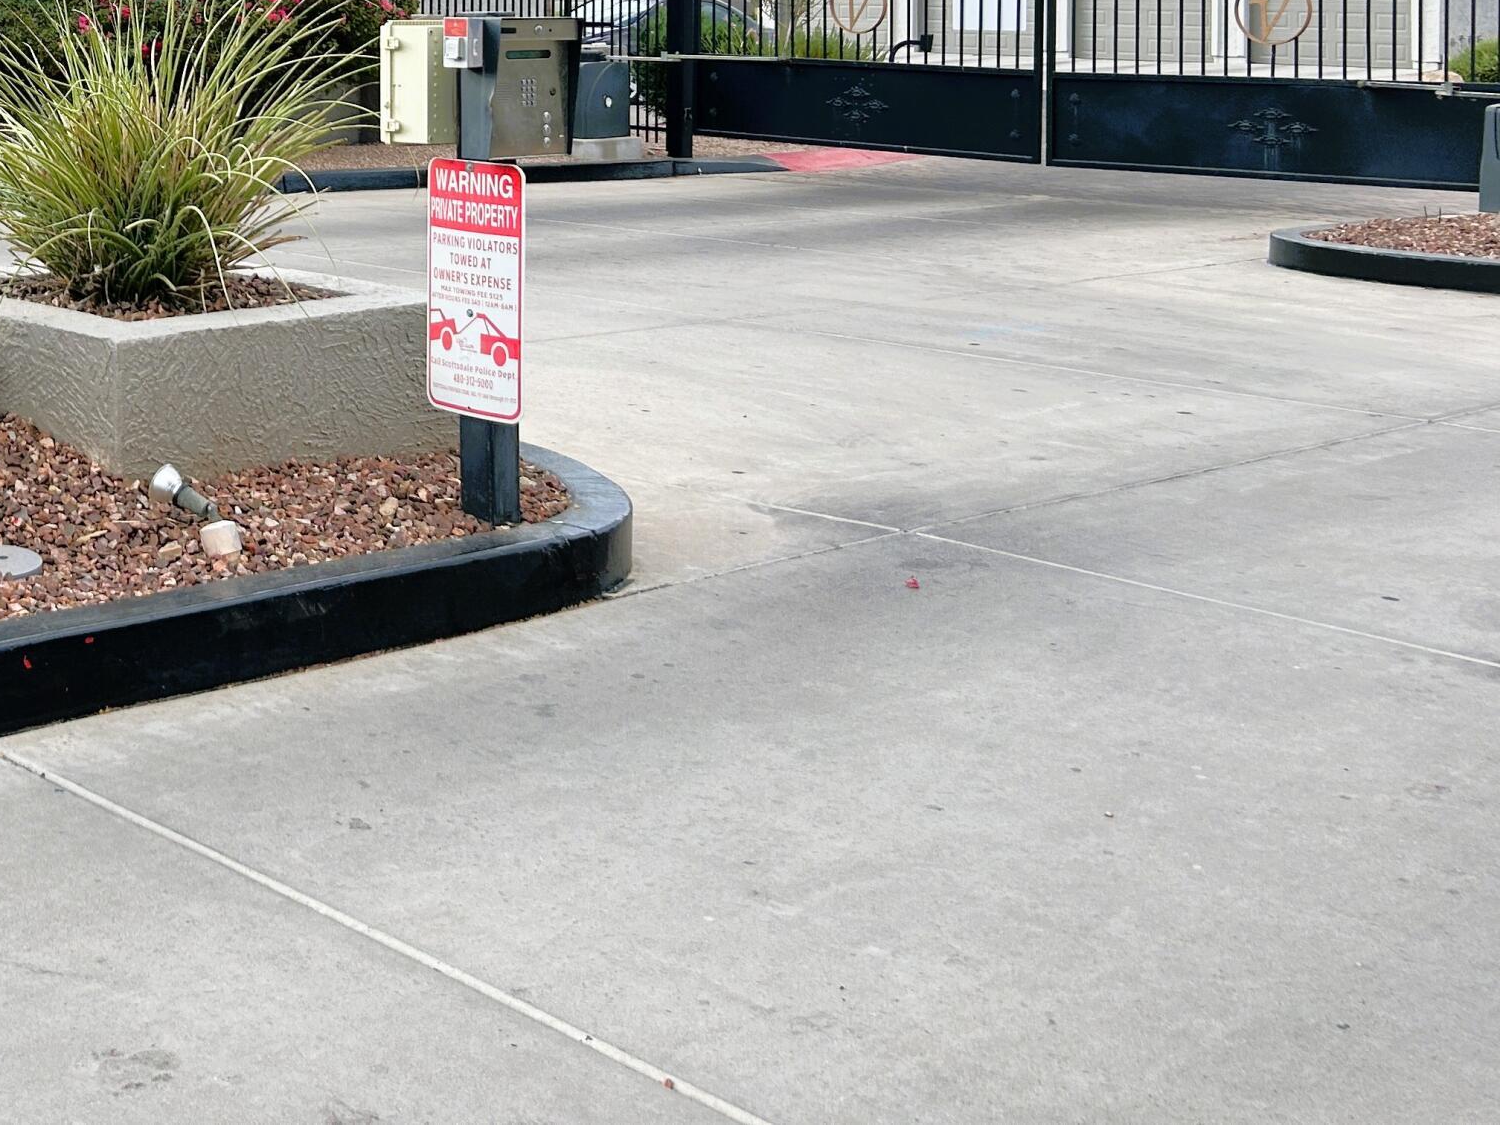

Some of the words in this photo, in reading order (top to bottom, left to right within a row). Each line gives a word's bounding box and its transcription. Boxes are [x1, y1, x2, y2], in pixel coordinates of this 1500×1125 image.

[435, 167, 513, 199] WARNING
[430, 196, 464, 224] PRIVATE
[465, 201, 518, 230] PROPERTY
[433, 231, 466, 249] PARKING
[467, 237, 518, 255] VIOLATORS
[450, 252, 478, 268] TOWED
[480, 257, 492, 270] AT
[433, 266, 468, 285] OWNER'S
[470, 273, 512, 291] EXPENSE
[442, 357, 475, 373] Scottsdale
[475, 365, 497, 377] Police
